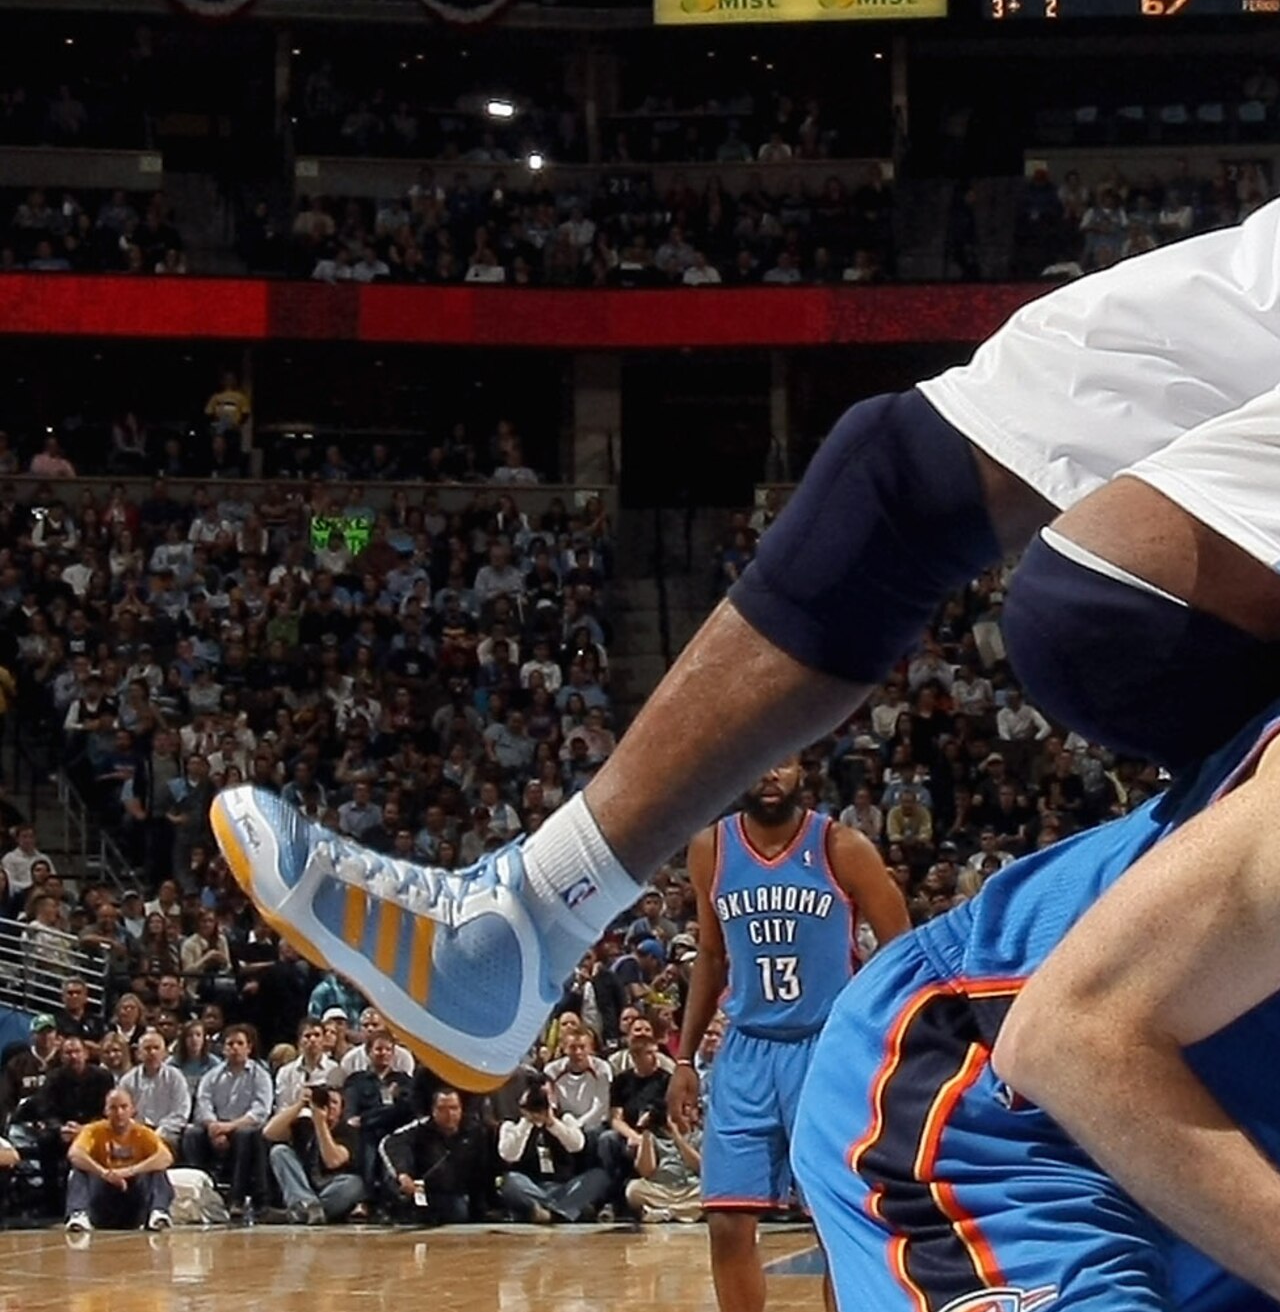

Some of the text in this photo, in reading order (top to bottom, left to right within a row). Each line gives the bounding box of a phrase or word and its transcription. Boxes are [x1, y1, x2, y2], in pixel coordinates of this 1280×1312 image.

[715, 885, 834, 922] OKLAHOMA
[749, 917, 798, 945] CITY
[756, 955, 802, 1003] 13
